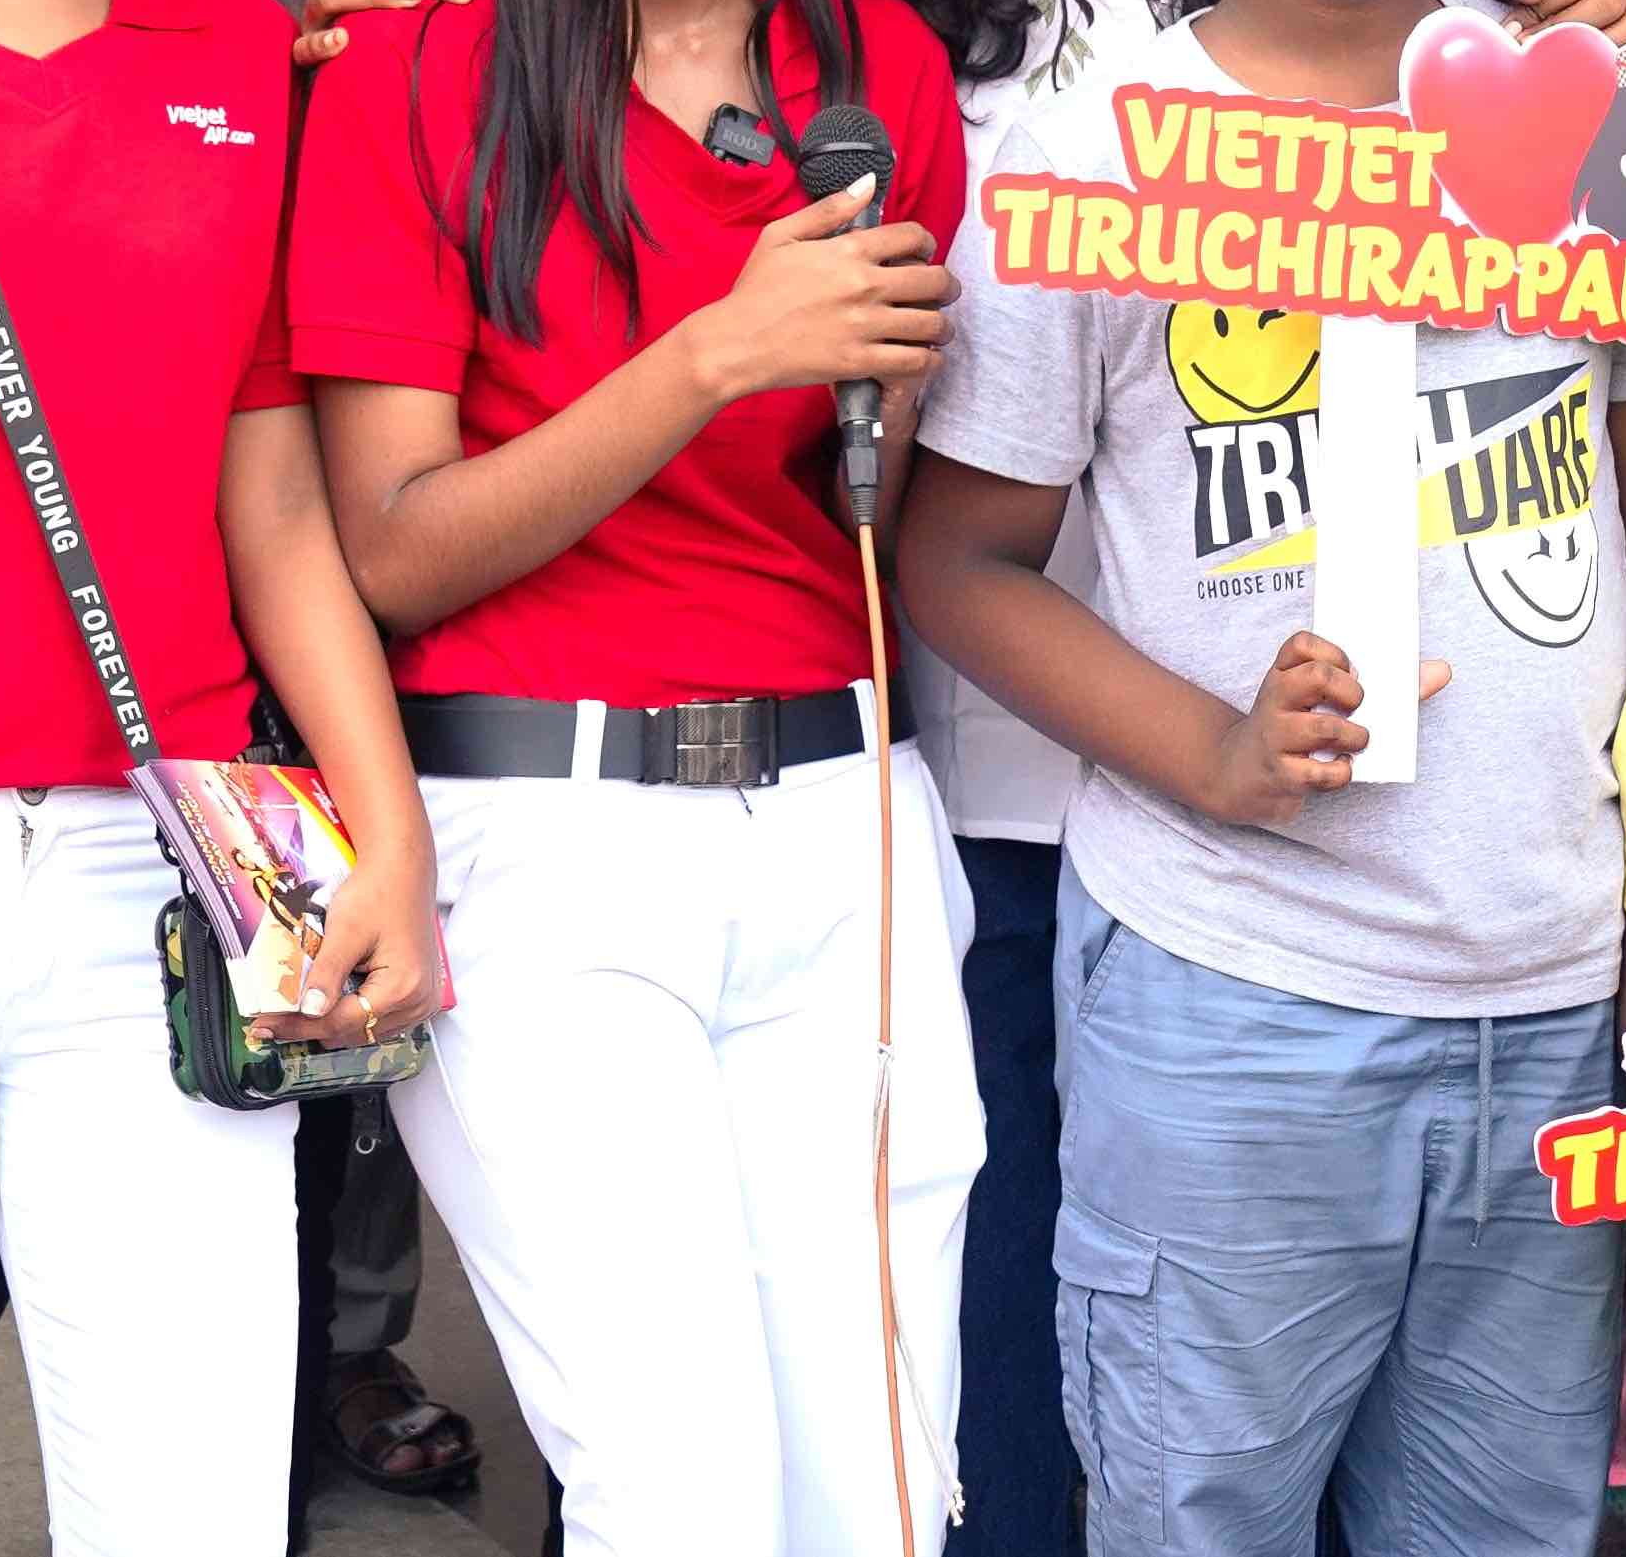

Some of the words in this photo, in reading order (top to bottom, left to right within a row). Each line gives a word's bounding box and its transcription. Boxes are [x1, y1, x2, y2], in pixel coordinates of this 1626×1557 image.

[1125, 98, 1449, 213] VIETJET
[17, 432, 79, 554] YOUNG
[71, 583, 151, 749] FOREVER
[1197, 573, 1265, 601] CHOOSE
[1272, 570, 1307, 593] ONE
